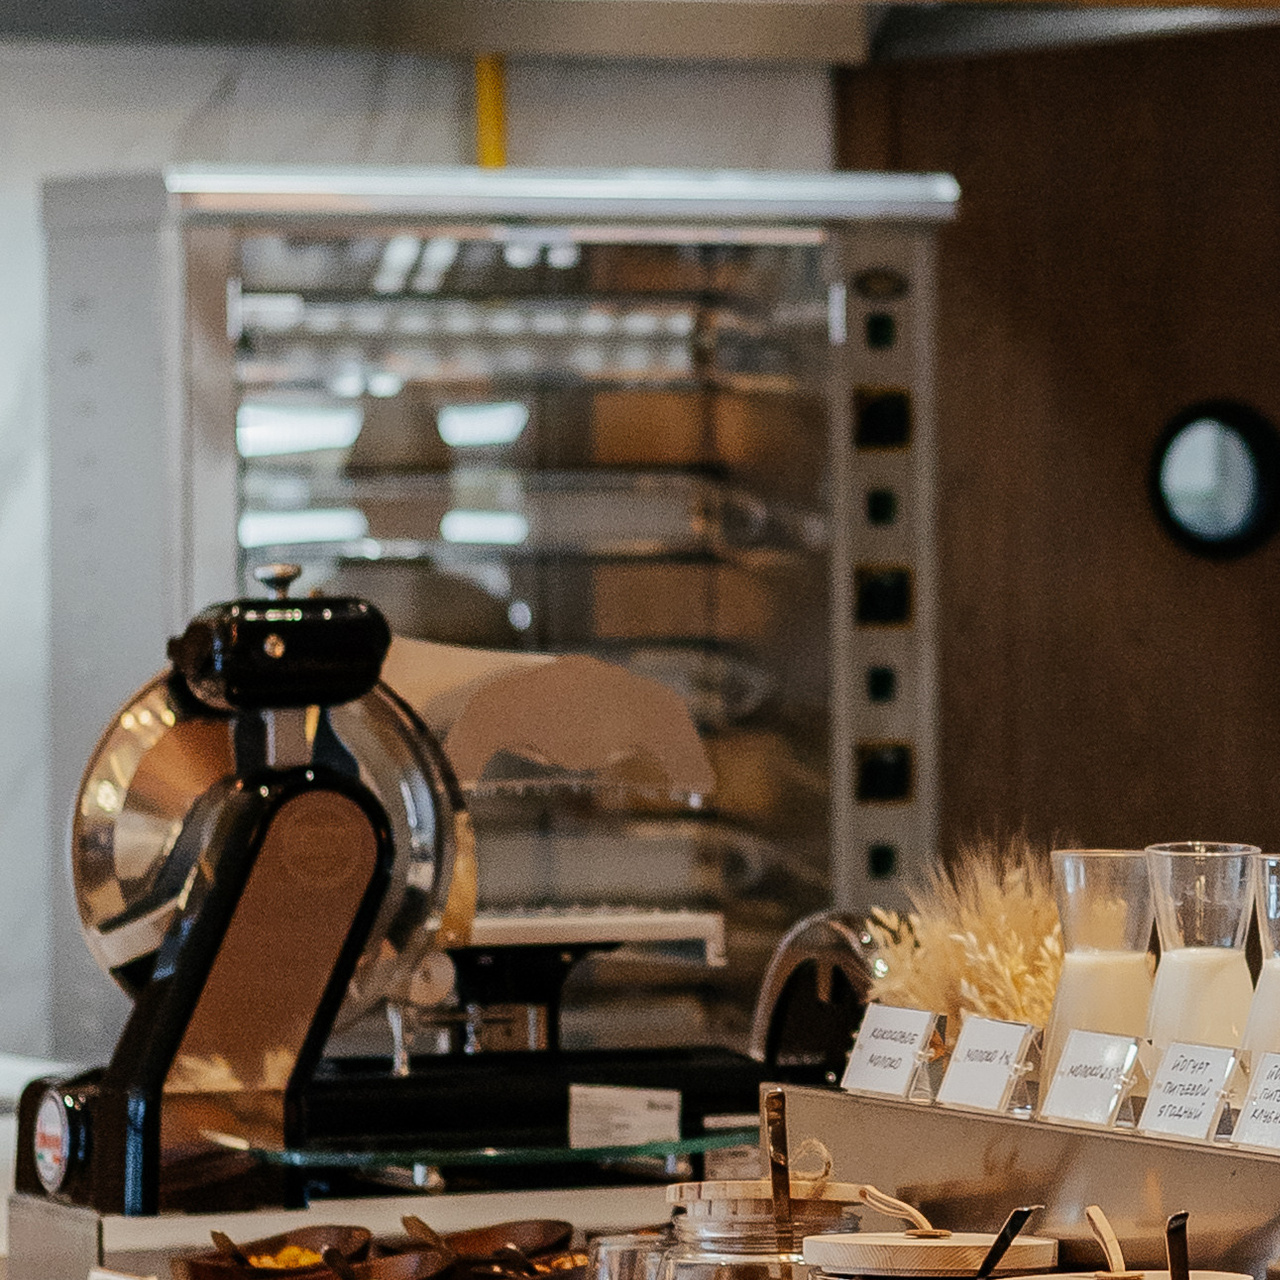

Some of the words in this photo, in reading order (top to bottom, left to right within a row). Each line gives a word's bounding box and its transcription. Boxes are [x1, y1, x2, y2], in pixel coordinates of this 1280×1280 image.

[866, 1053, 902, 1070] МОЛОКО
[965, 1048, 998, 1063] МОЛОКО
[1171, 1054, 1210, 1075] ЙОГУРТ
[1162, 1078, 1213, 1096] ПИТЬЕВОЙ
[1158, 1102, 1206, 1120] ЯГОДНЫЙ
